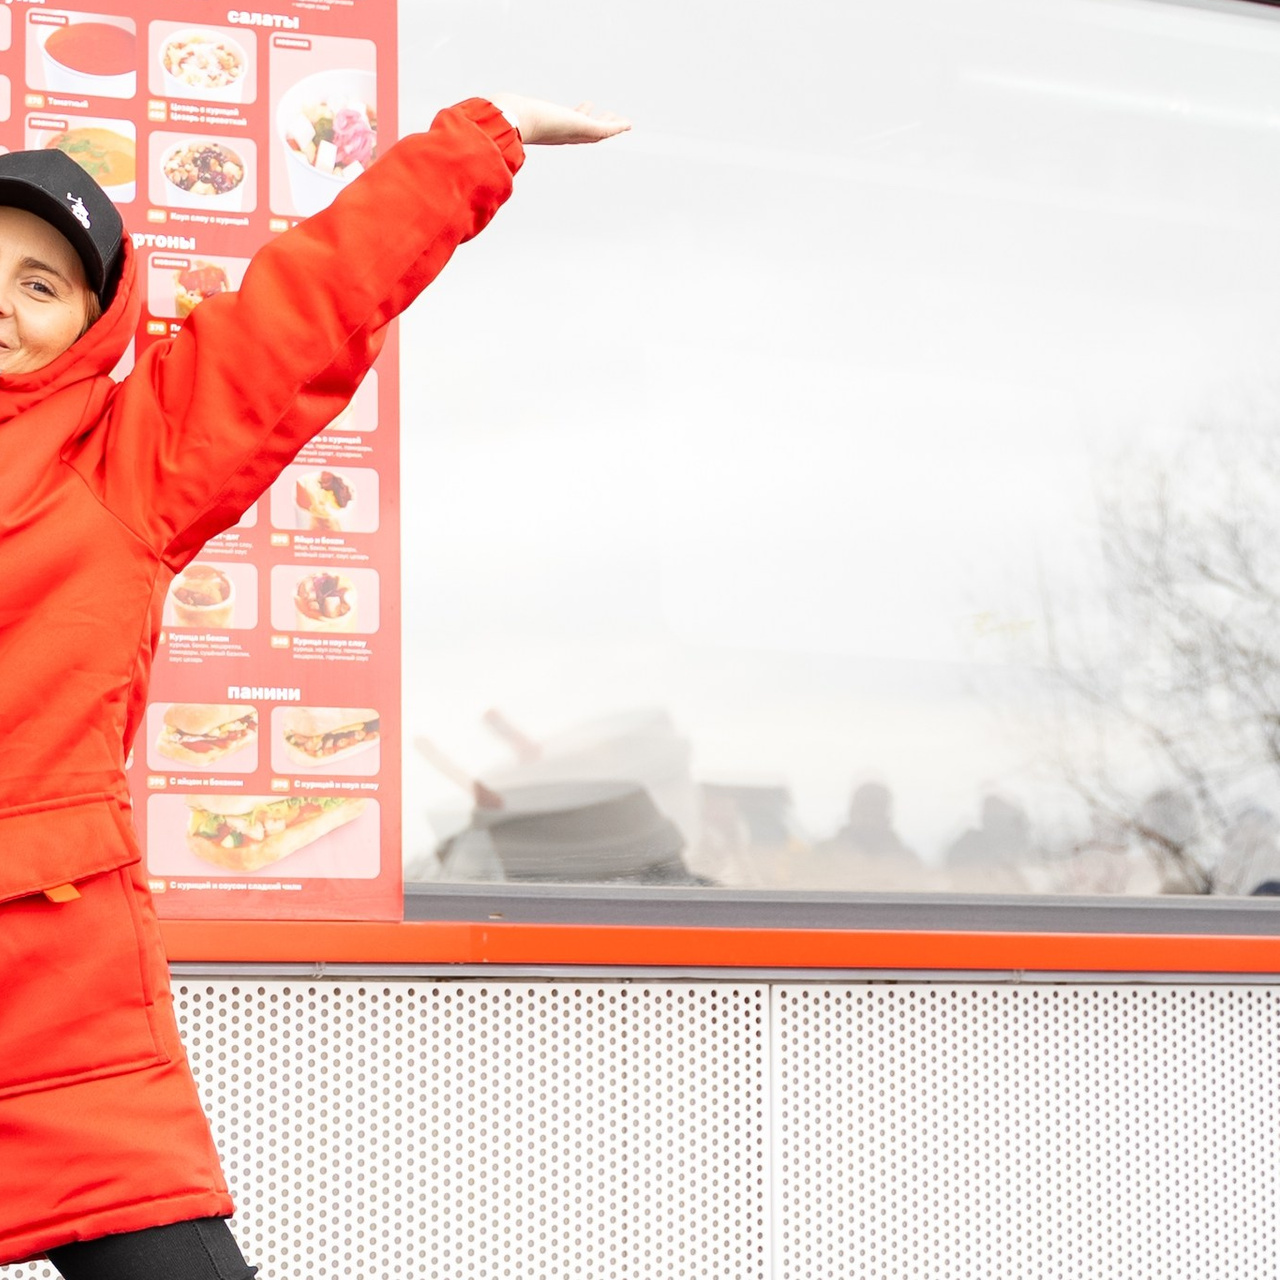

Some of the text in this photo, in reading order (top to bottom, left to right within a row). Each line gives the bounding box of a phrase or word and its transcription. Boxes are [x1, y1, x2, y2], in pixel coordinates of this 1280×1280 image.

[227, 10, 299, 29] салаты
[132, 233, 196, 250] ртоны
[228, 686, 301, 701] панини
